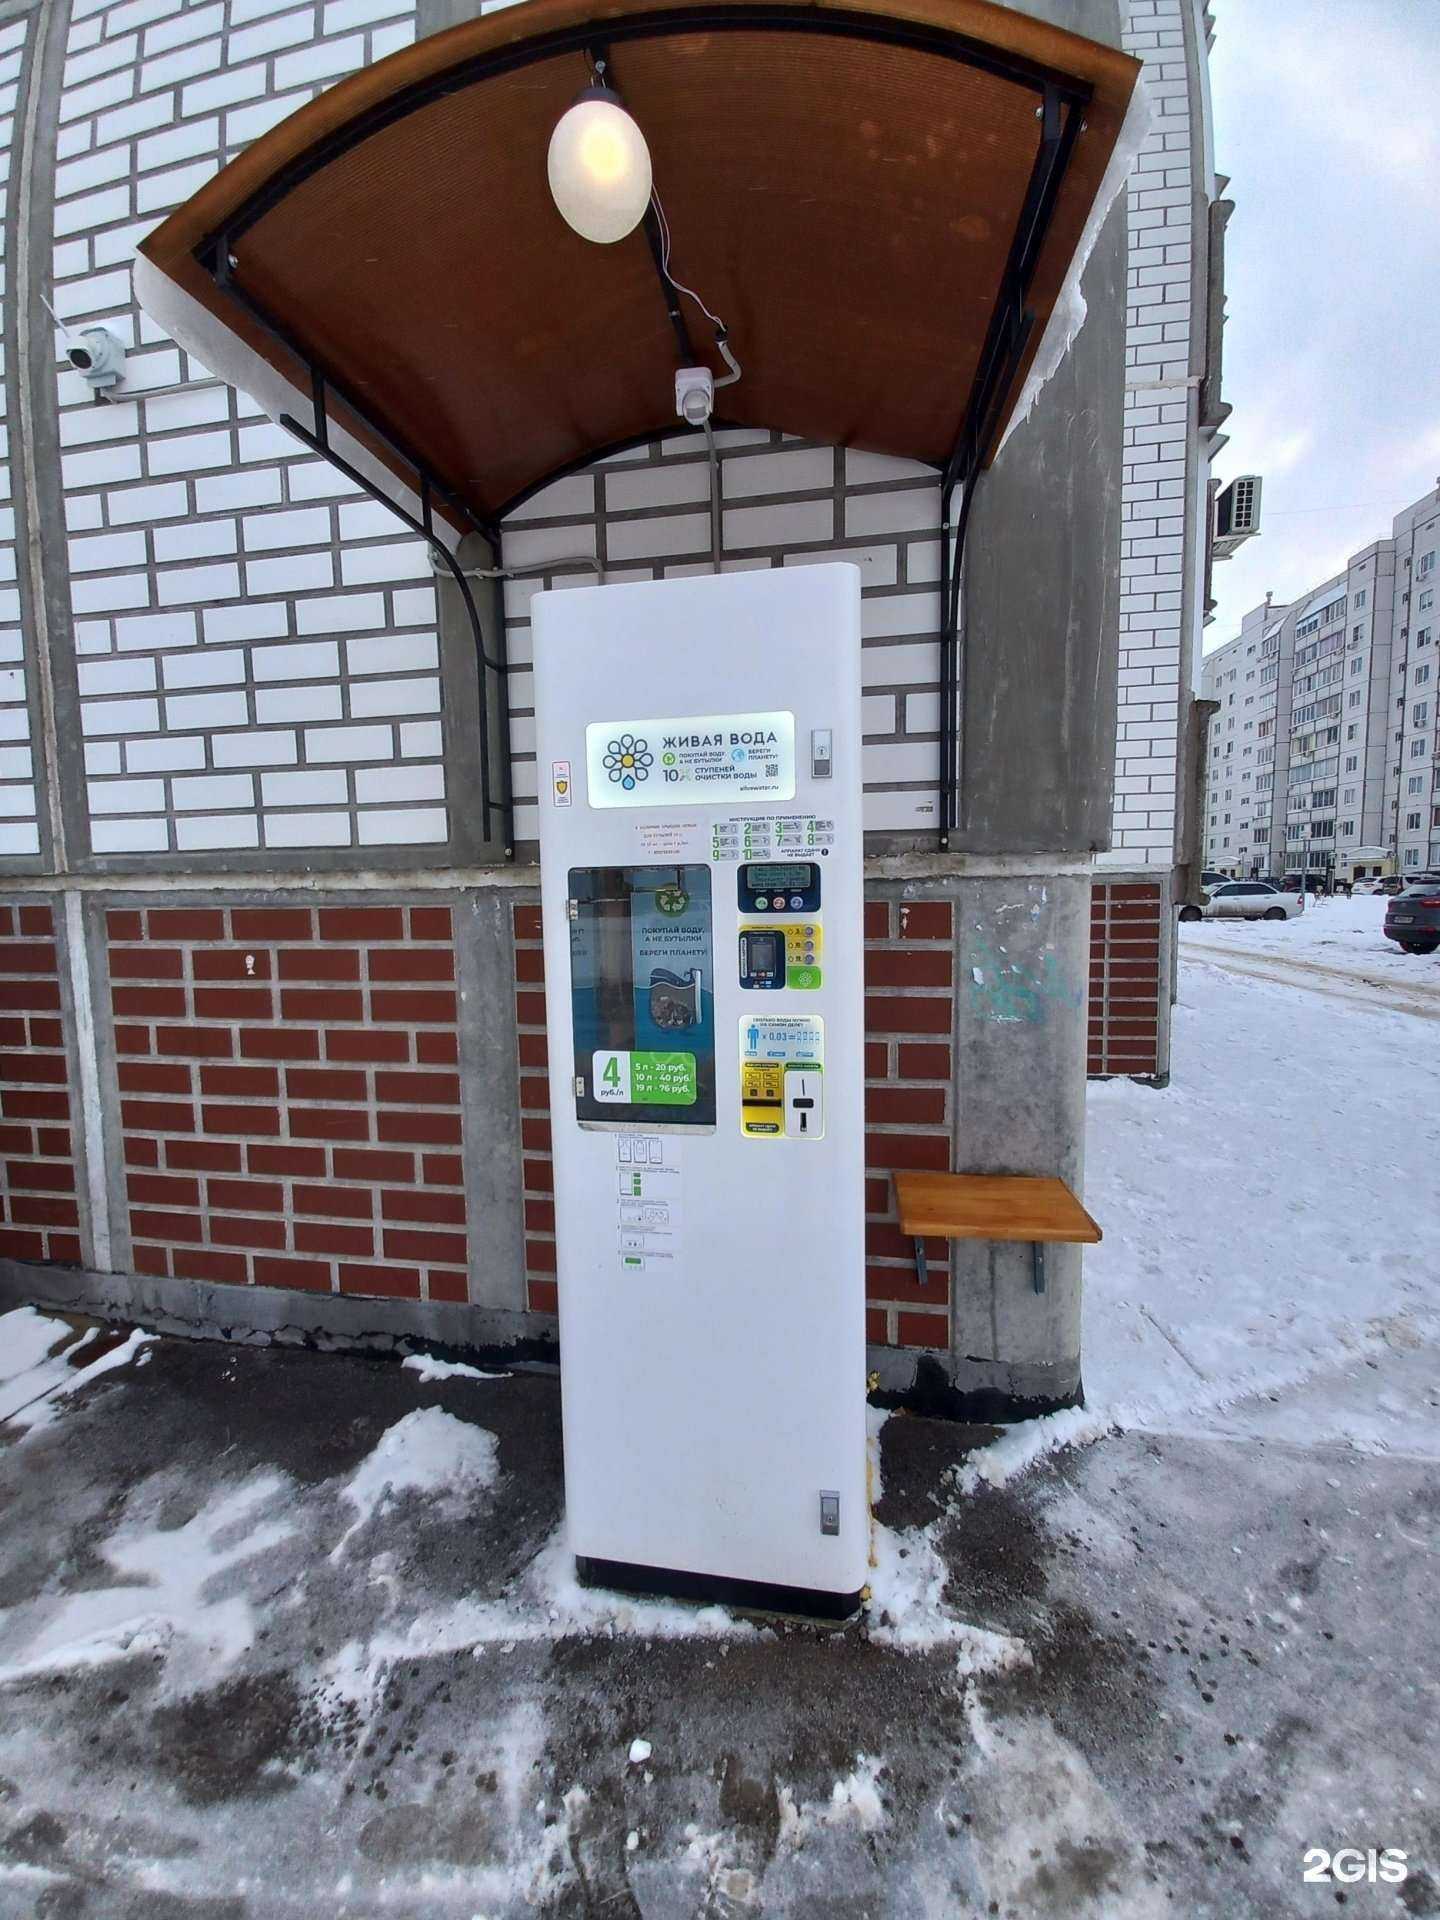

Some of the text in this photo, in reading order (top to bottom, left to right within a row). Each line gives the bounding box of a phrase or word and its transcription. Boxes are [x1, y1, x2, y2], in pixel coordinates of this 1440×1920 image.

[662, 731, 778, 749] ЖИВАЯ ВОДА
[695, 765, 736, 774] СТУПЕНЕЙ
[695, 773, 732, 781] ОЧИСТКИ
[712, 823, 718, 835] 1
[744, 822, 752, 834] 2
[775, 821, 783, 833] 3
[807, 820, 815, 832] 4
[712, 836, 720, 848] 5
[744, 835, 751, 847] 6
[776, 835, 784, 846] 7
[807, 833, 815, 845] 8
[712, 849, 720, 861] 9
[641, 926, 680, 934] ПОКУПАЙ
[602, 1056, 622, 1088] 4
[635, 1063, 641, 1071] 5
[655, 1063, 666, 1071] 20
[668, 1063, 687, 1073] руб.
[636, 1073, 645, 1081] 10
[659, 1073, 671, 1081] 40
[672, 1074, 691, 1083] руб.
[600, 1088, 624, 1097] руб./л
[636, 1083, 645, 1091] 19
[659, 1084, 670, 1092] 76
[671, 1084, 690, 1094] руб.
